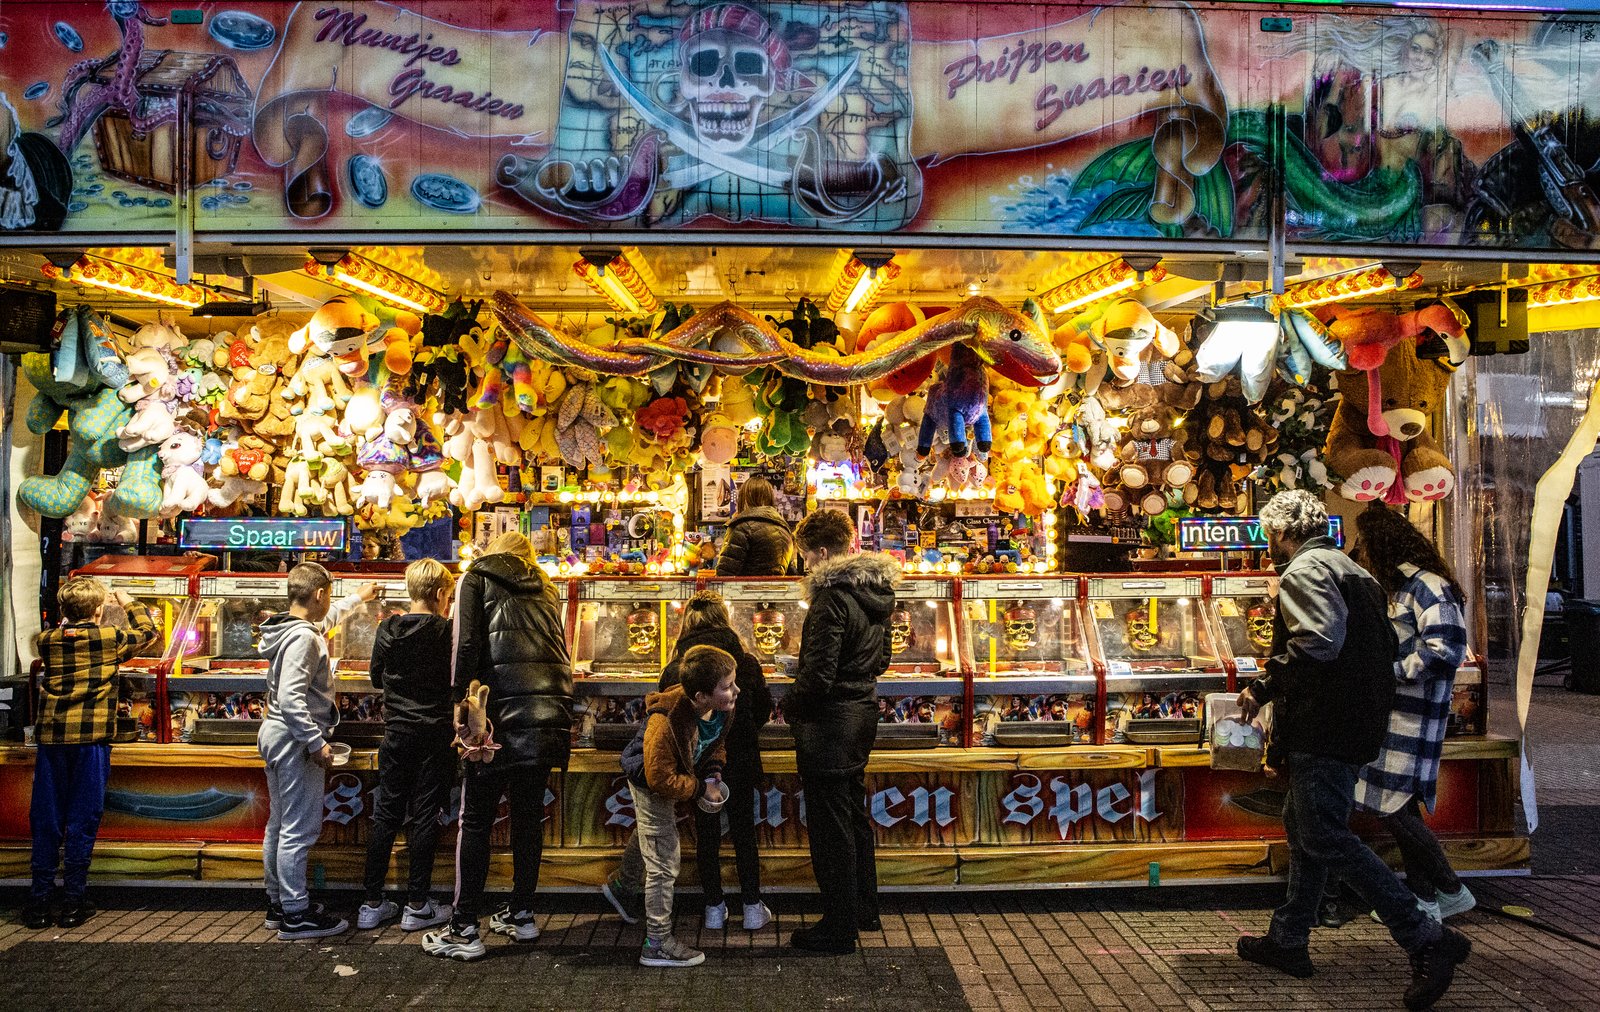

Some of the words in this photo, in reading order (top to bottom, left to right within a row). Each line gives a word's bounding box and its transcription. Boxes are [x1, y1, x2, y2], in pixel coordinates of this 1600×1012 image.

[313, 7, 461, 68] Muntjes
[388, 68, 525, 120] Graaien
[943, 39, 1090, 99] Prijzen
[229, 525, 297, 546] Spaar
[304, 530, 338, 546] uw
